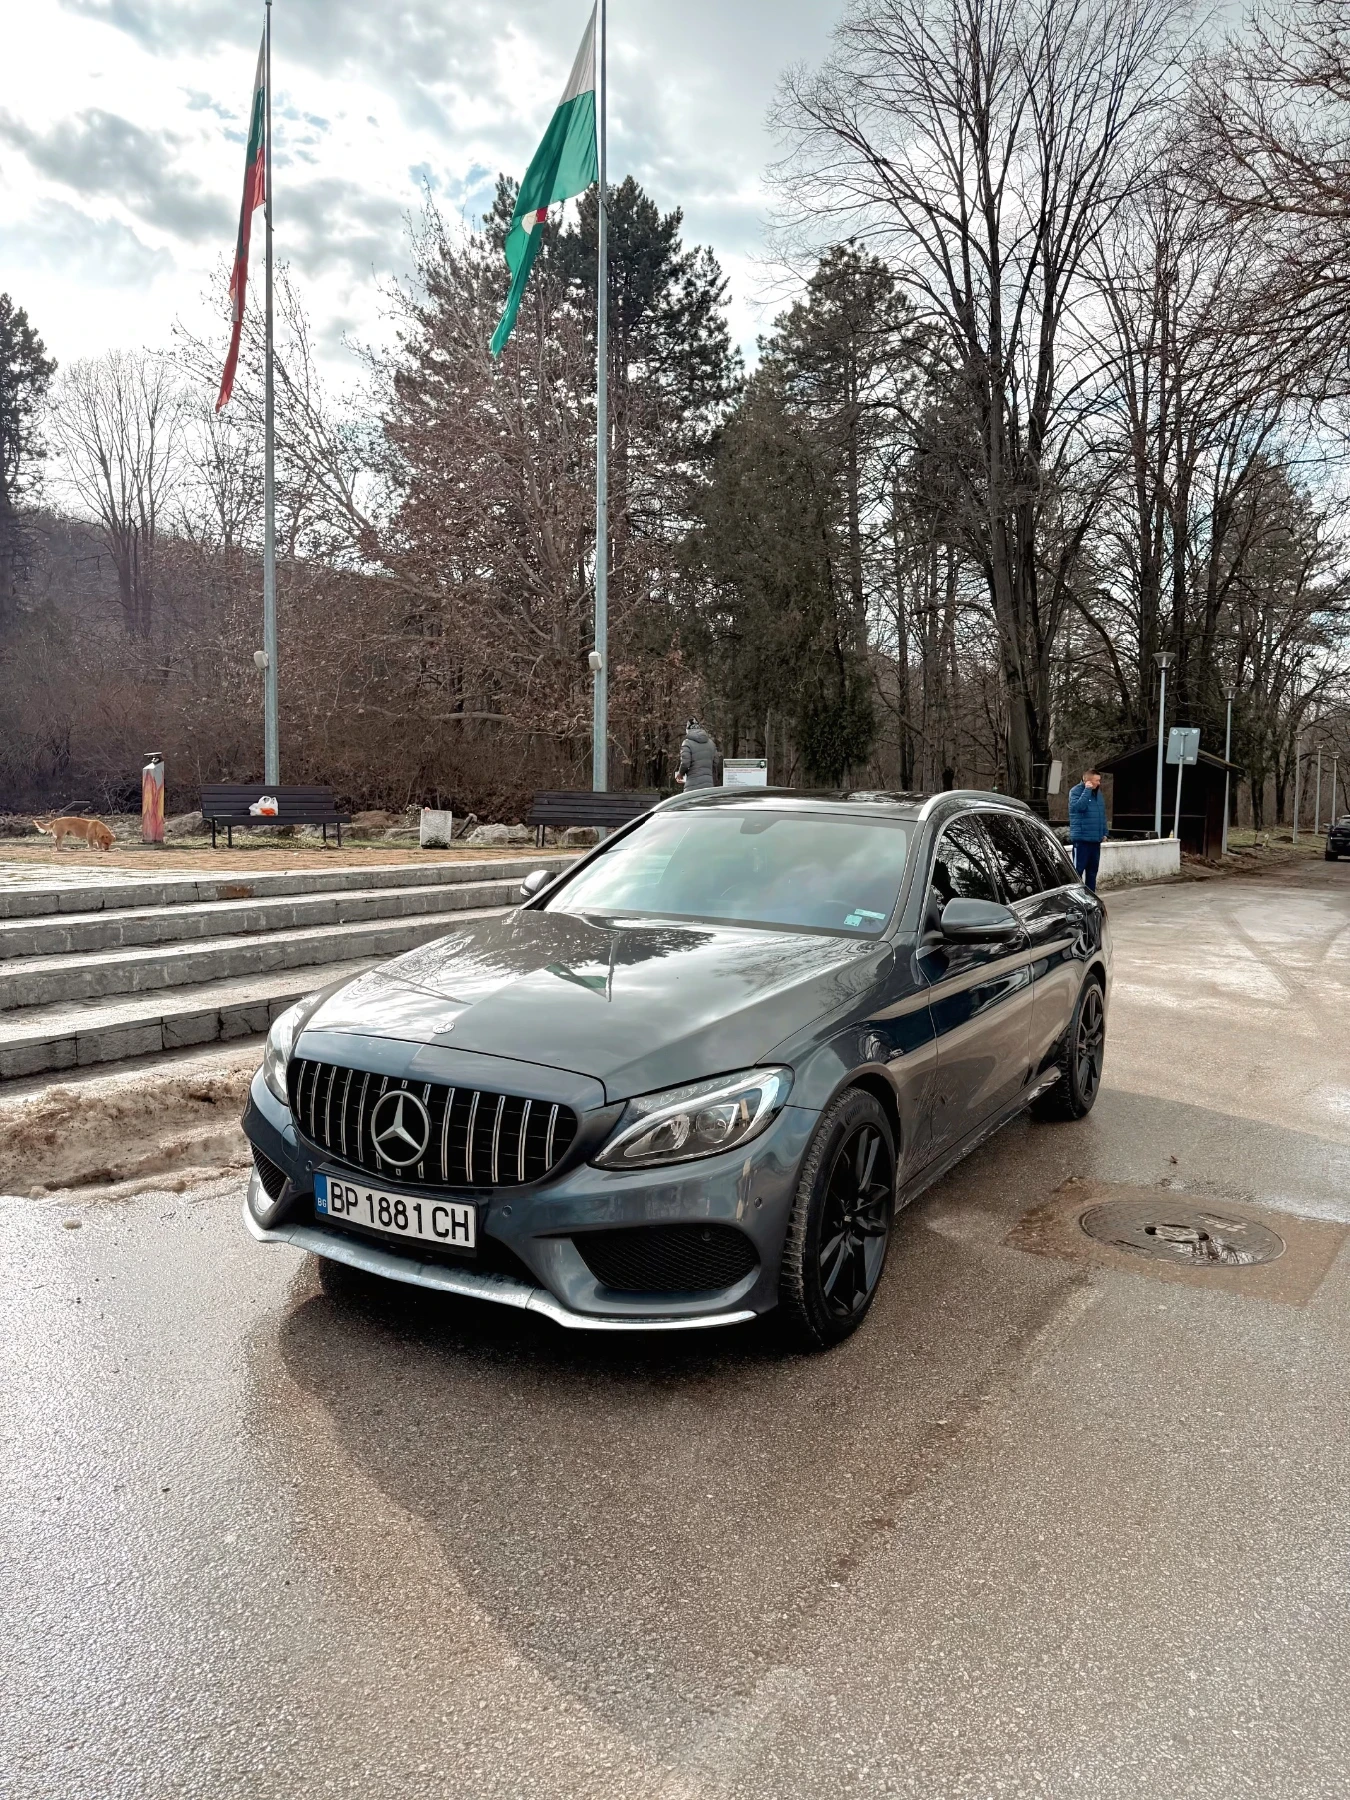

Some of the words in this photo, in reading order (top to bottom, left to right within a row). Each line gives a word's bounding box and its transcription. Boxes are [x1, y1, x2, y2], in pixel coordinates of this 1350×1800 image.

[317, 1197, 327, 1208] BG
[330, 1181, 358, 1216] BP
[365, 1193, 423, 1234] 1881
[431, 1206, 470, 1242] CH
